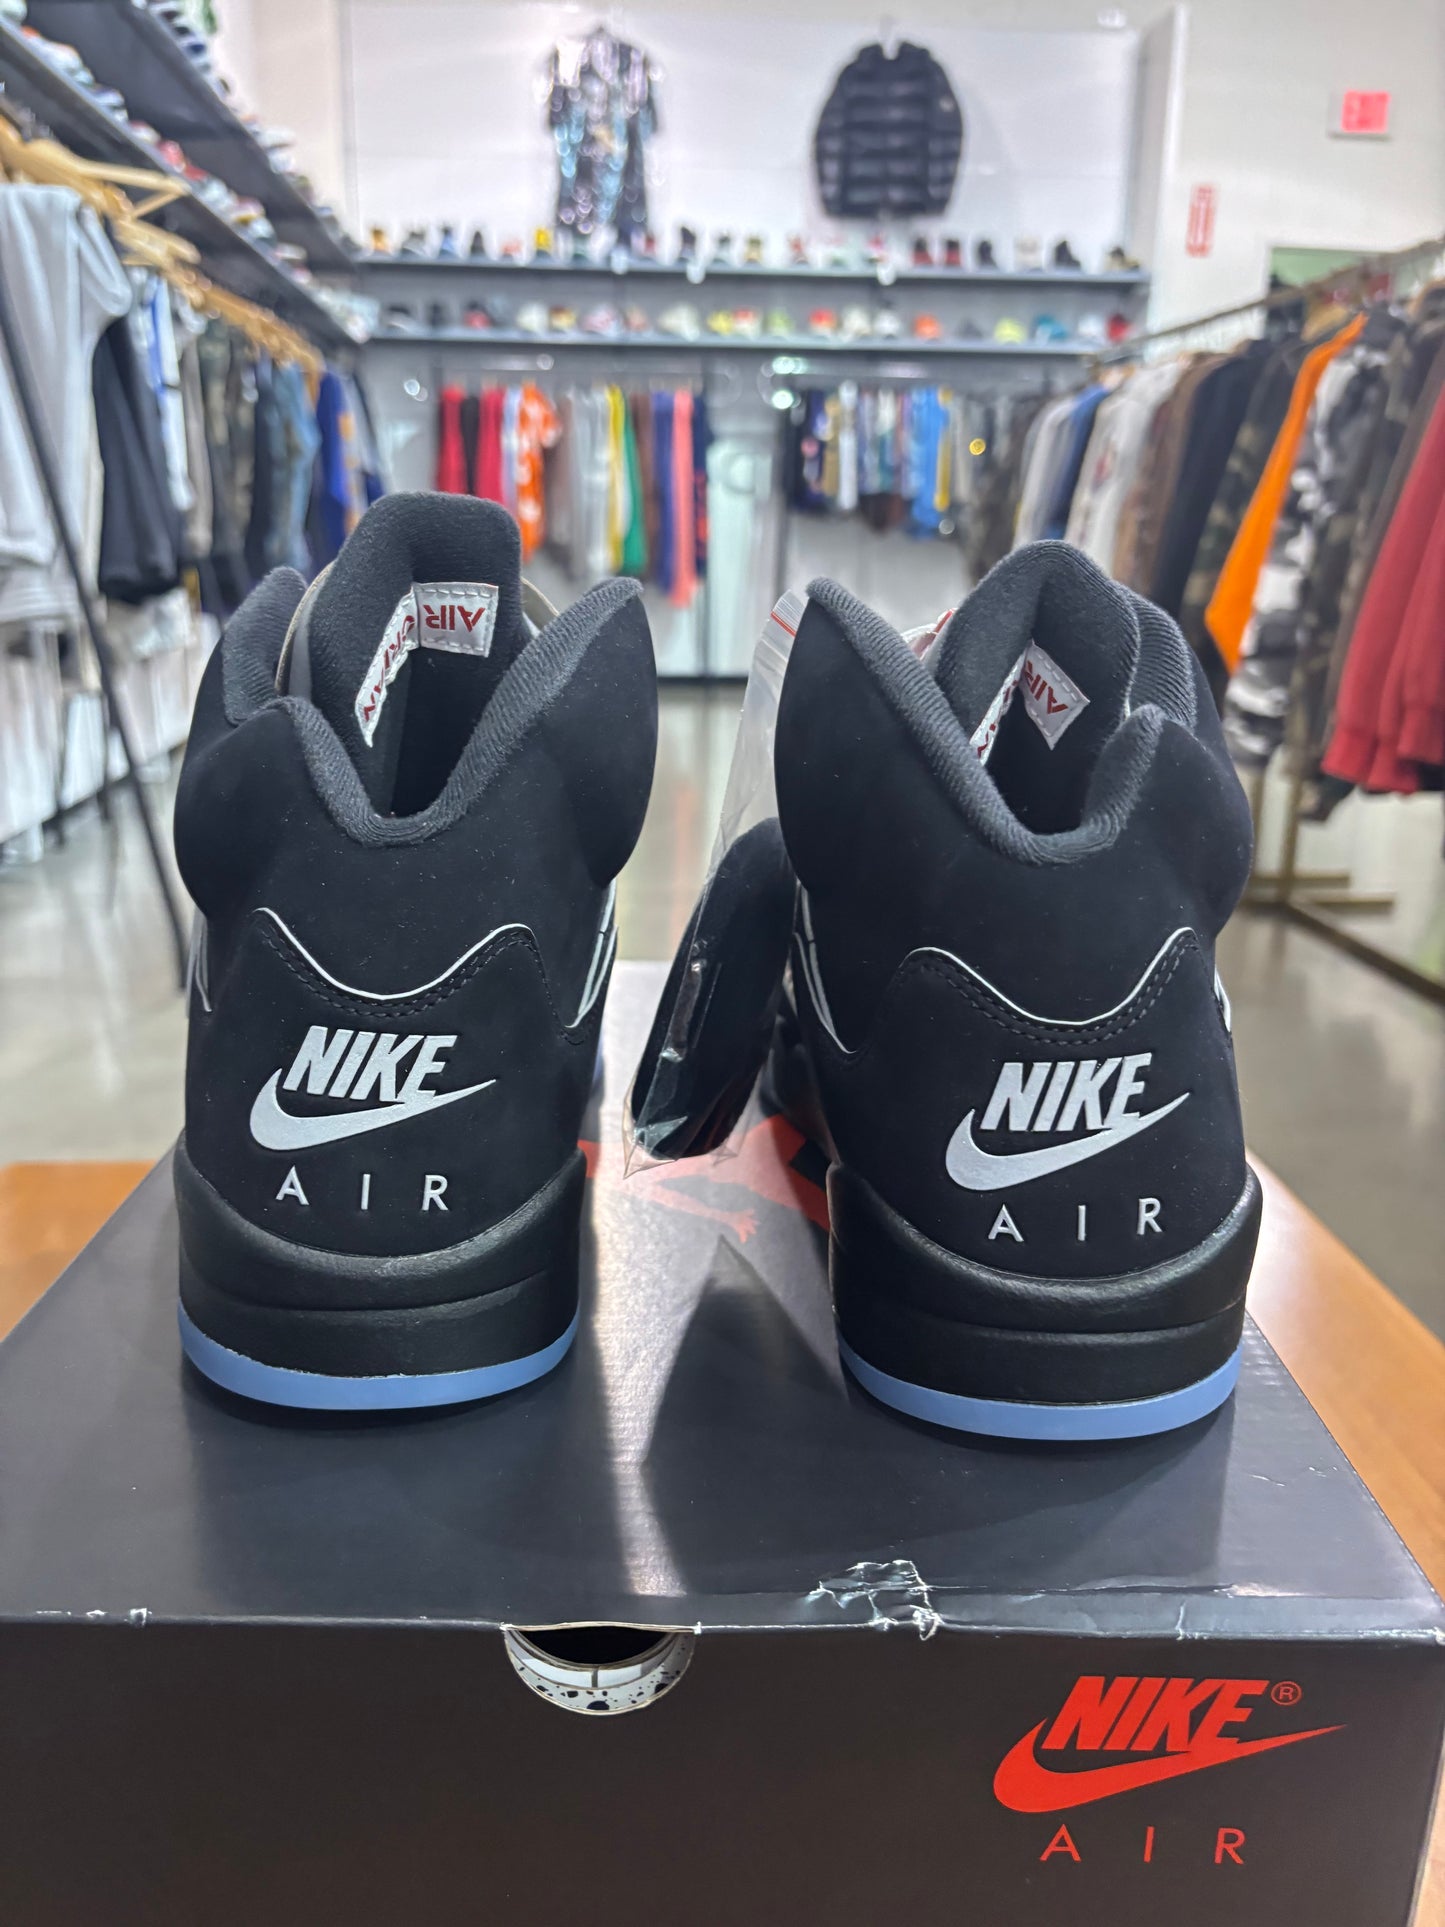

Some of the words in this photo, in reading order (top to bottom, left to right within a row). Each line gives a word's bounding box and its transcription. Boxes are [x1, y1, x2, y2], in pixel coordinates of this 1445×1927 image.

[423, 604, 486, 633] AIR
[282, 1025, 458, 1104] NIKE
[979, 1052, 1152, 1132] NIKE
[275, 1165, 449, 1211] AIR
[987, 1197, 1163, 1242] AIR
[1041, 1675, 1270, 1752] NIKE
[1039, 1823, 1246, 1865] AIR
